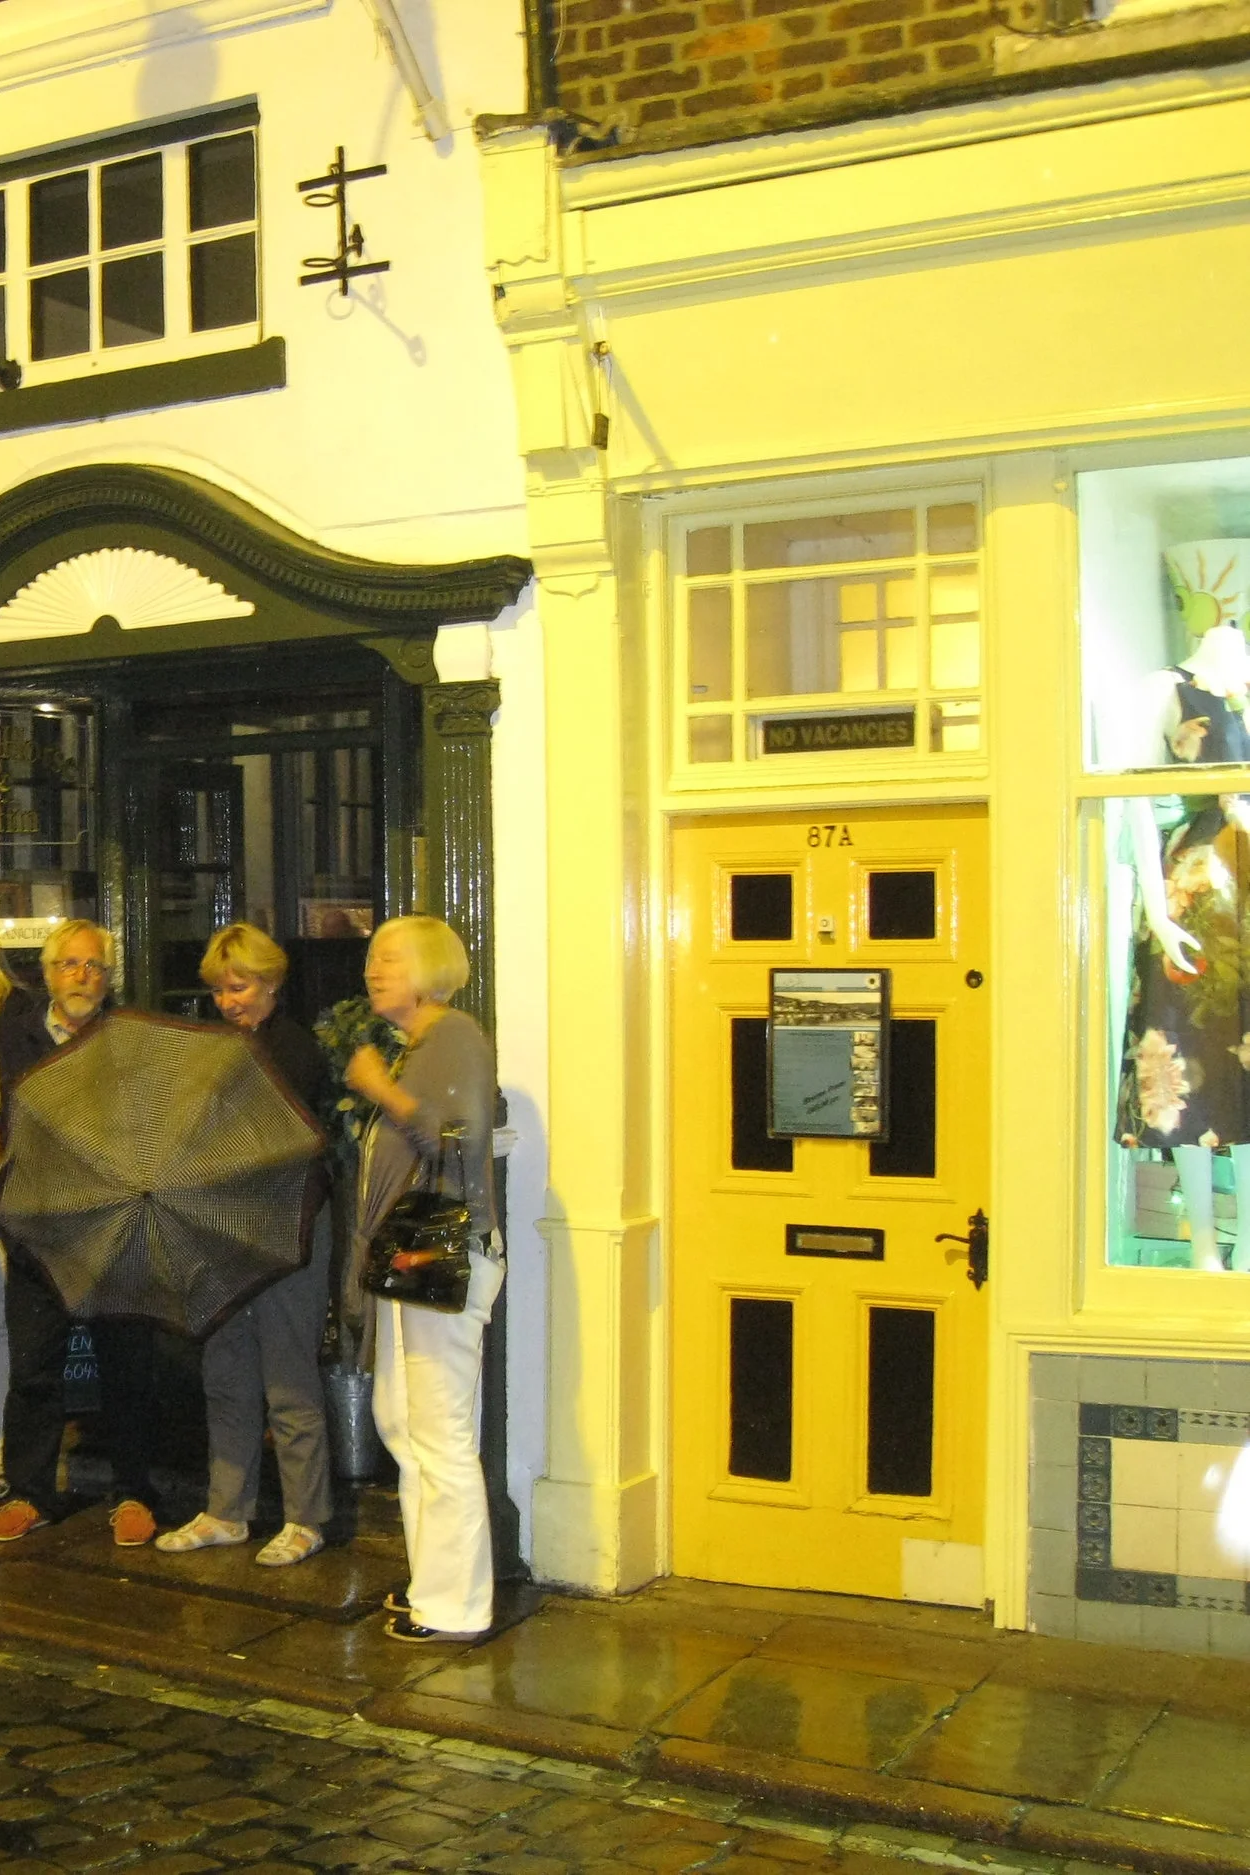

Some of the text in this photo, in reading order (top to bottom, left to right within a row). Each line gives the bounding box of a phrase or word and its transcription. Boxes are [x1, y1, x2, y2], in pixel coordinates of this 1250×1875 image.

[769, 719, 908, 747] NO VACANCIES
[807, 825, 854, 848] 87A
